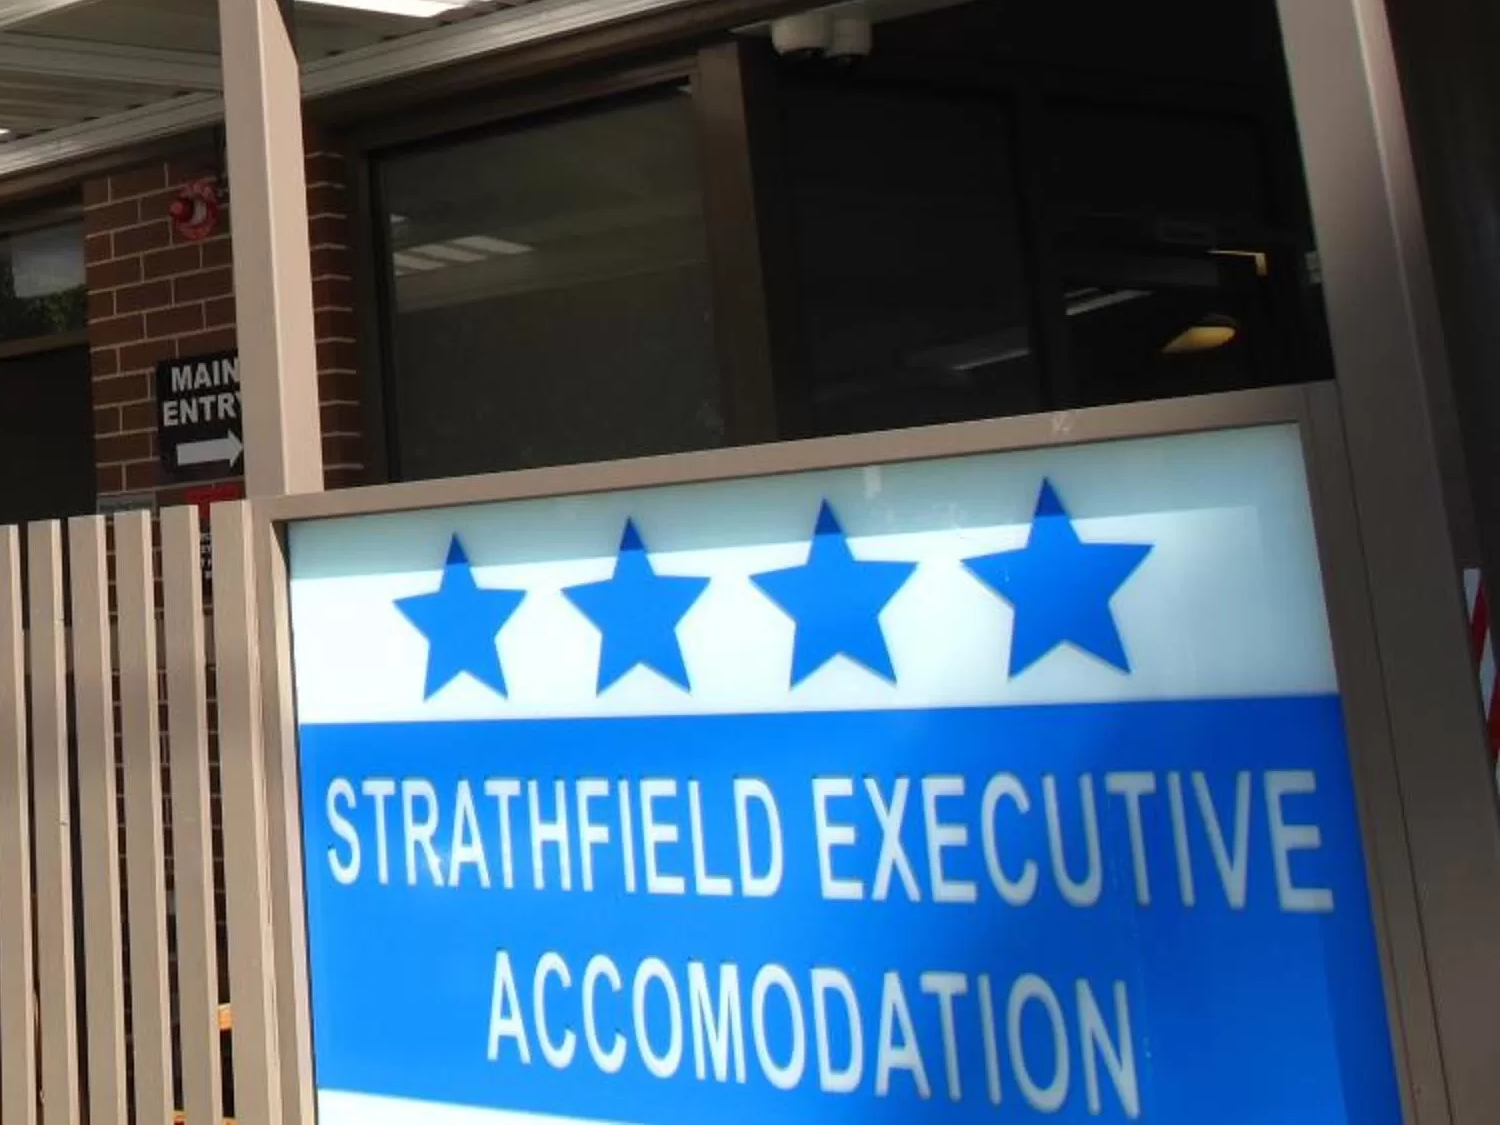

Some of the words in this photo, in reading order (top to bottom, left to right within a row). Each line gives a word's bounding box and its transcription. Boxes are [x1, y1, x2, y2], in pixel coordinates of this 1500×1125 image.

[171, 357, 240, 393] MAIN
[326, 776, 785, 900] STRATHFIELD
[814, 768, 1335, 913] EXECUTIVE
[487, 948, 1142, 1120] ACCOMODATION
